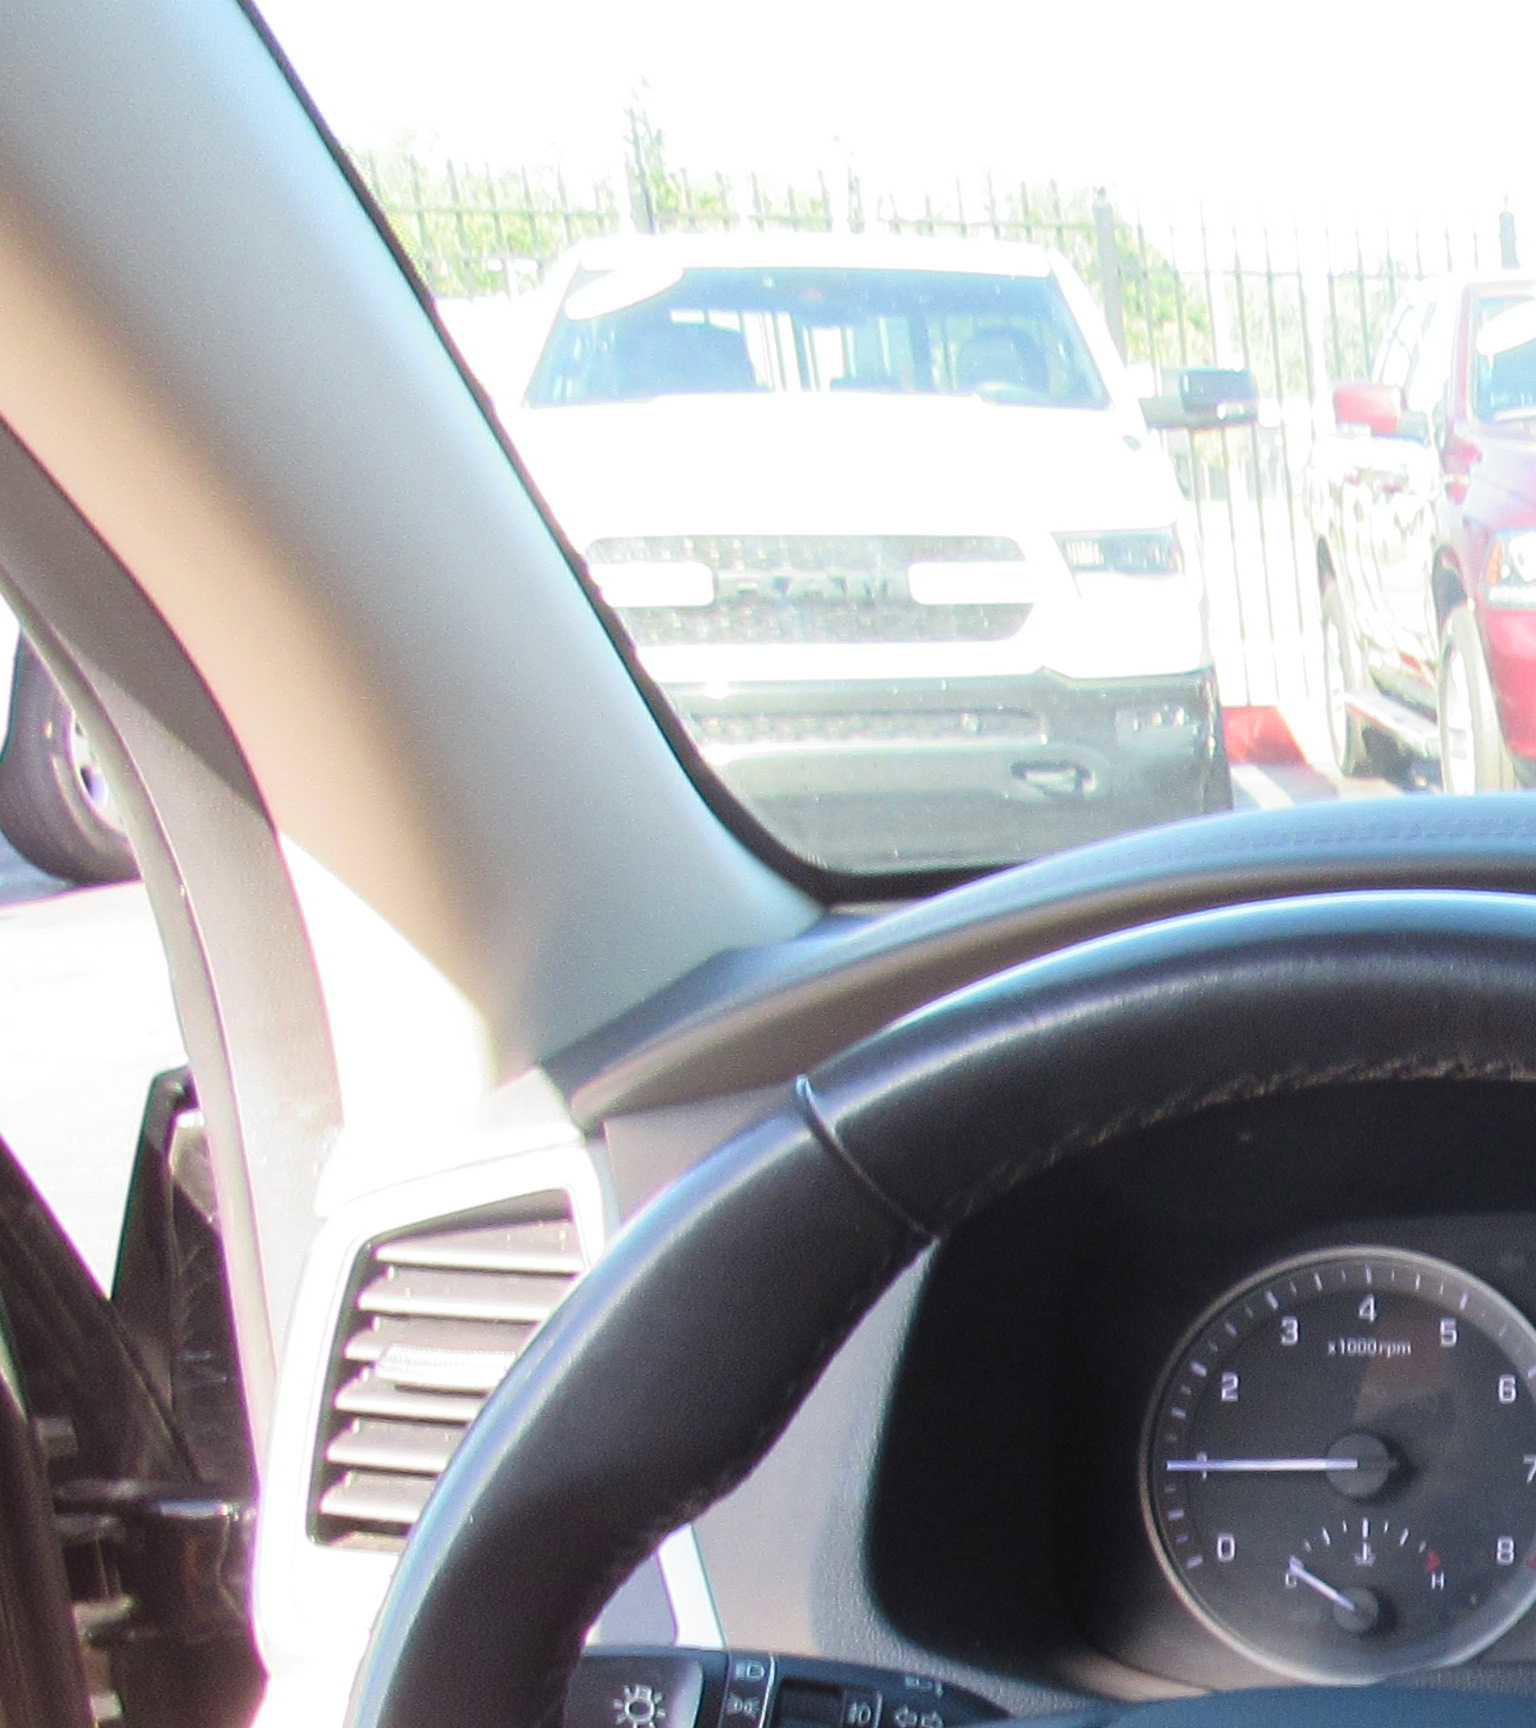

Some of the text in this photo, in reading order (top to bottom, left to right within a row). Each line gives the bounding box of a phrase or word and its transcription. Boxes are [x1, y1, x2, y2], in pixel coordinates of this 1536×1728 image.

[1358, 1296, 1377, 1324] 4
[1281, 1316, 1299, 1346] 3
[1440, 1318, 1458, 1348] 5
[1220, 1372, 1239, 1402] 2
[1498, 1374, 1517, 1404] 6
[1217, 1533, 1236, 1563] 0
[1496, 1536, 1515, 1566] 8
[1430, 1573, 1446, 1590] H
